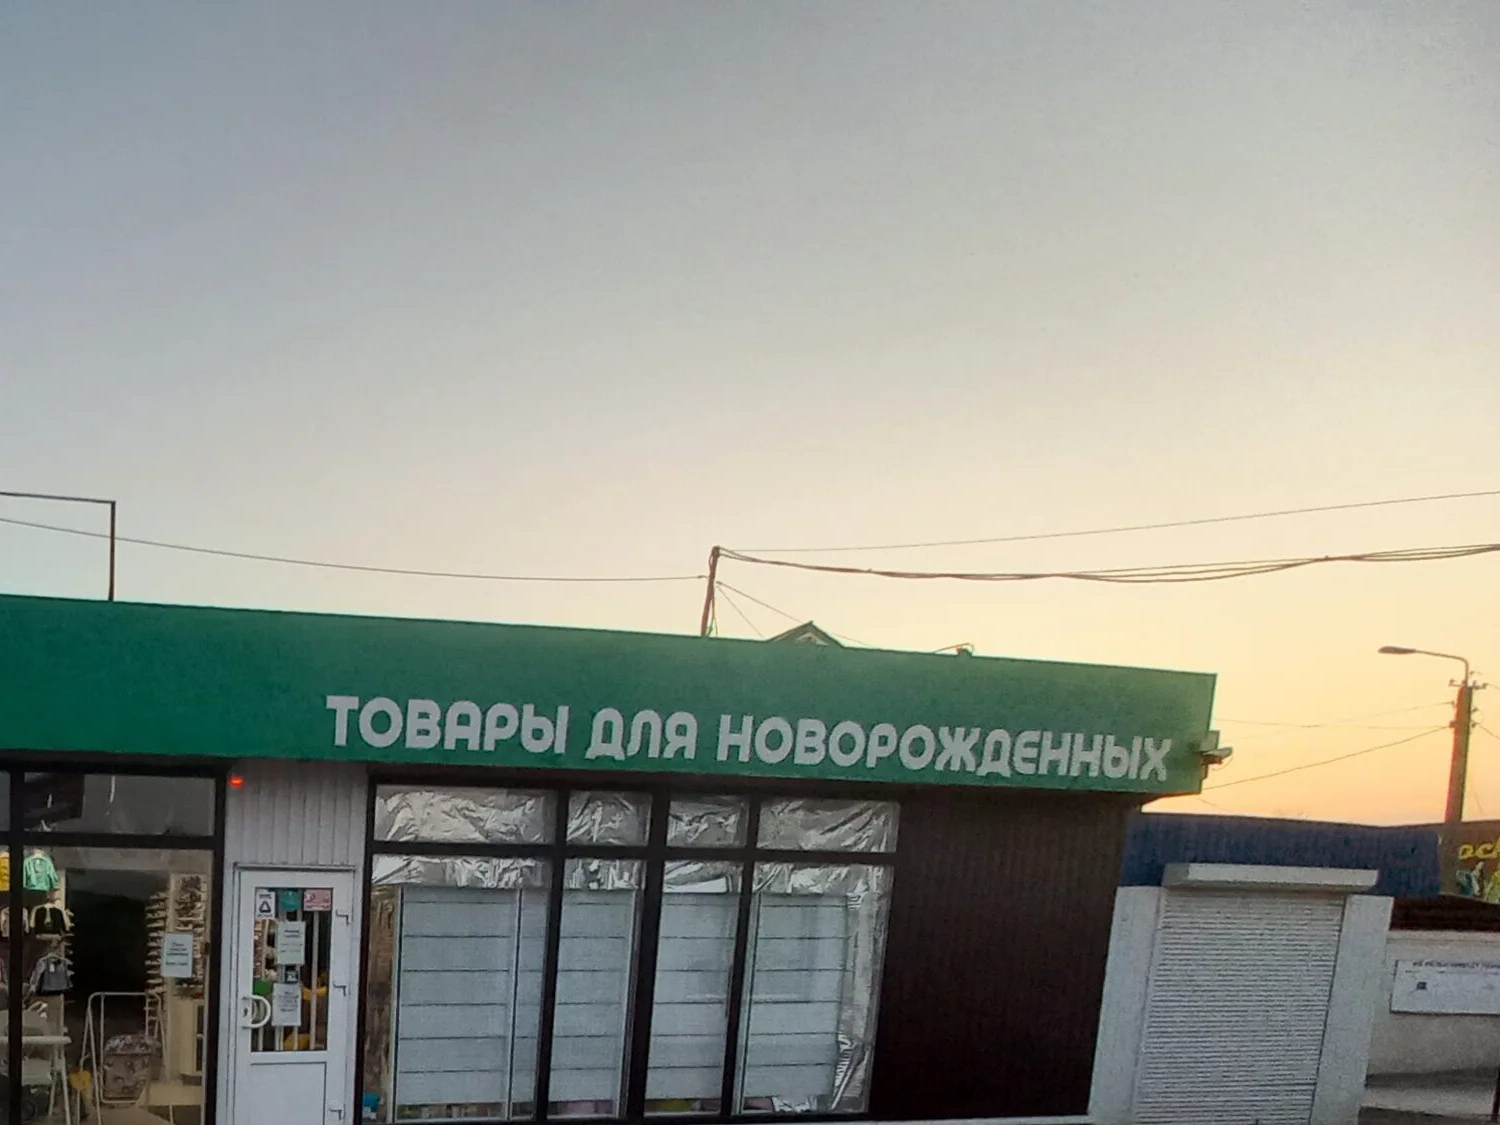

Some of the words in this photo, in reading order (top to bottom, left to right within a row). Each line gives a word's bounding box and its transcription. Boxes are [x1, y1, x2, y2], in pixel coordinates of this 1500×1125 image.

[325, 694, 570, 755] ТОВАРЫ
[584, 706, 699, 762] ДЛЯ
[715, 713, 1173, 782] НОВОРОЖДЕННЫХ
